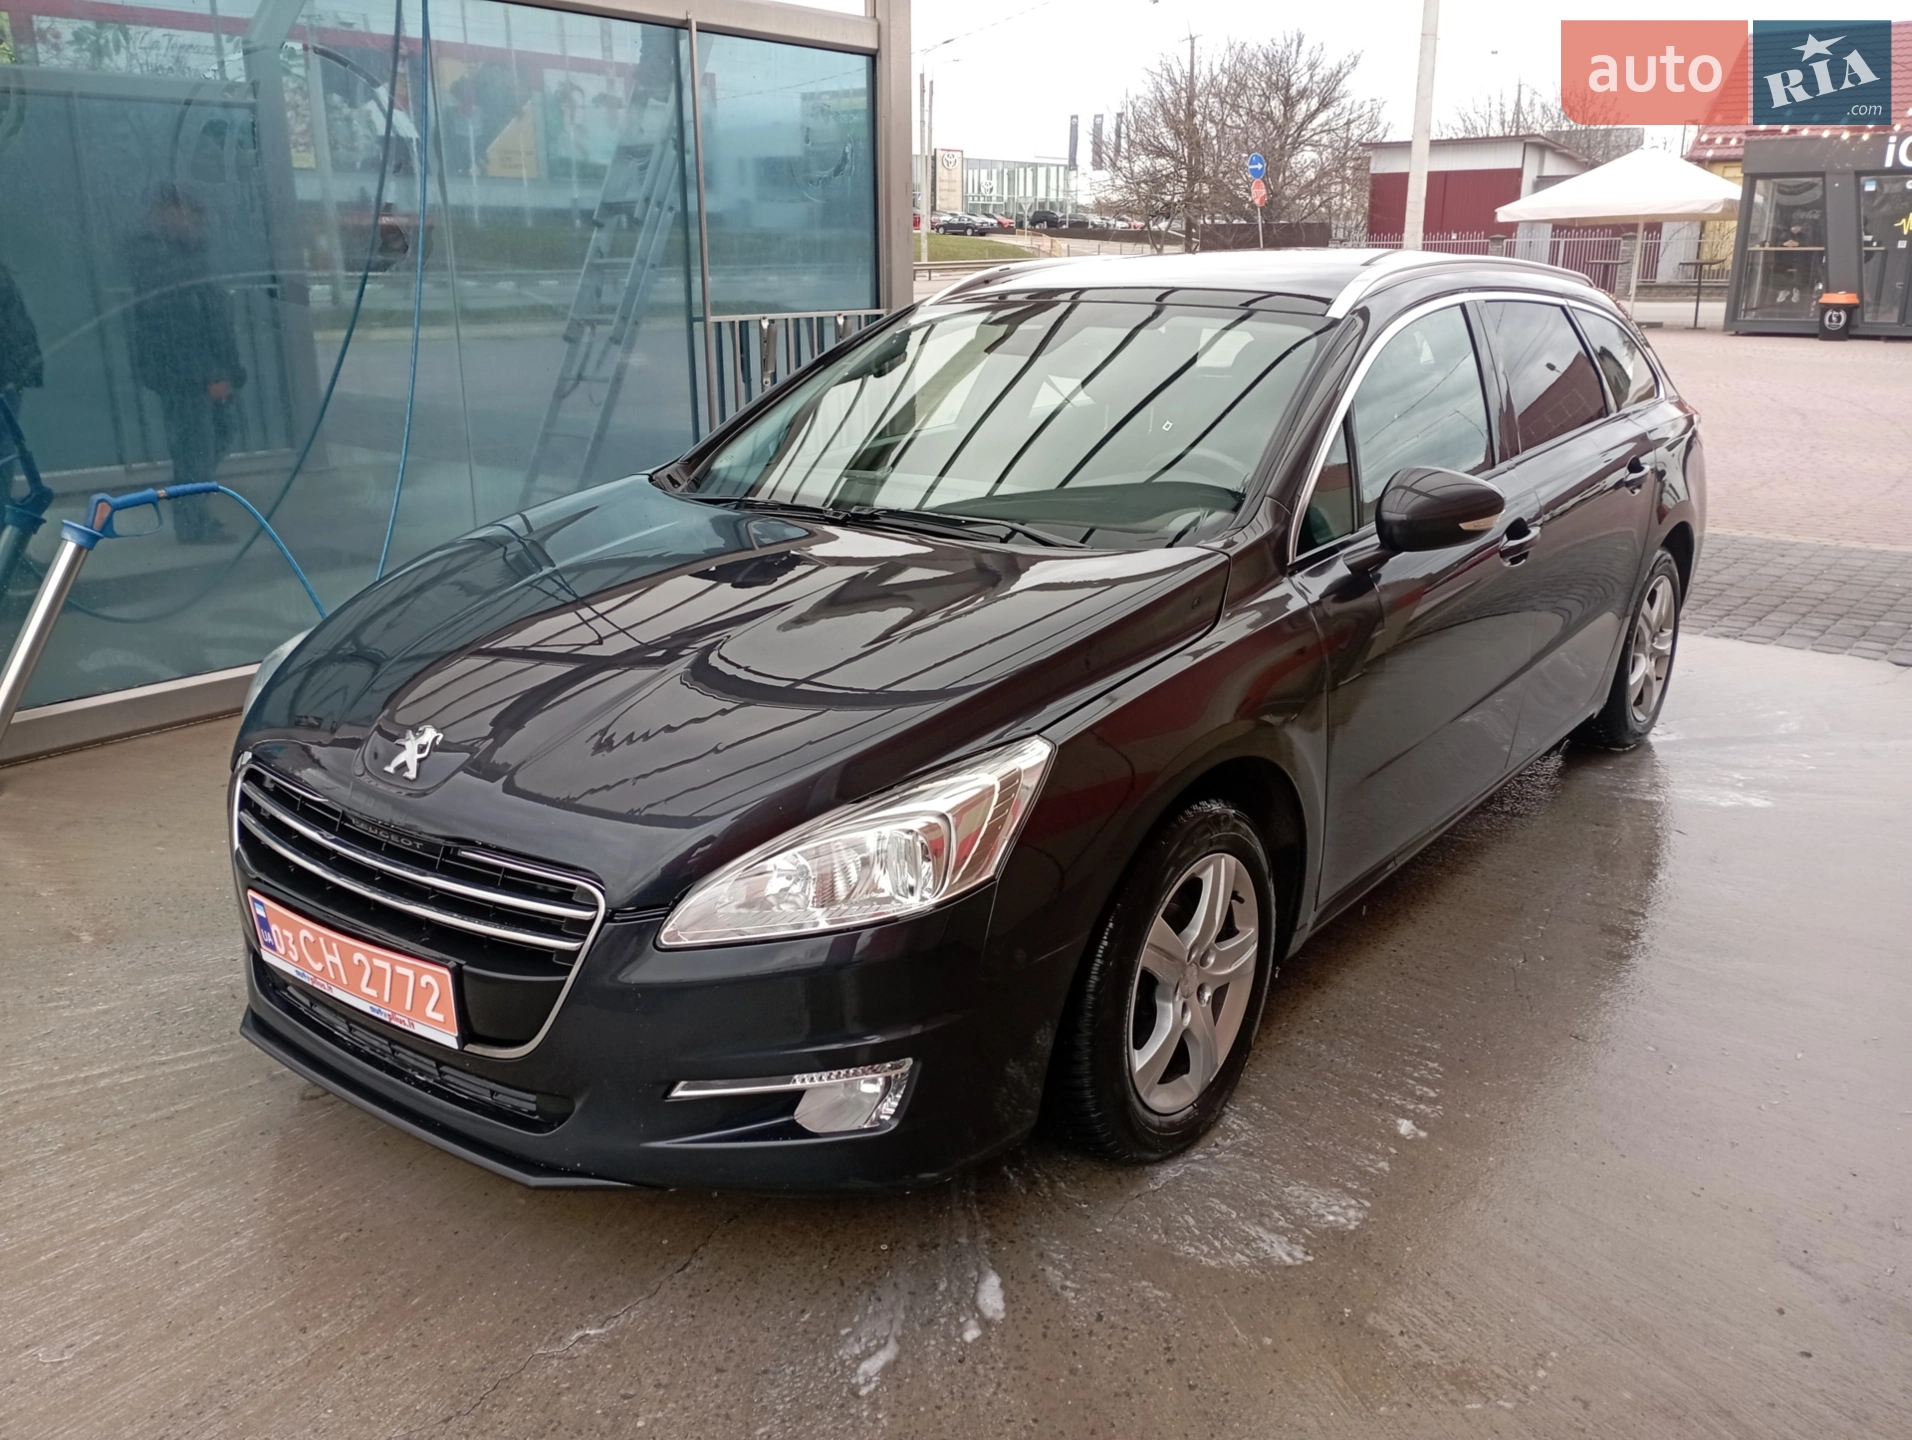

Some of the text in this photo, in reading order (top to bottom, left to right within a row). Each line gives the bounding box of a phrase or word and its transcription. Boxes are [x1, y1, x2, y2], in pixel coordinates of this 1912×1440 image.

[351, 818, 424, 849] PEUGEOT
[261, 929, 275, 946] UA
[353, 952, 445, 1023] 2772
